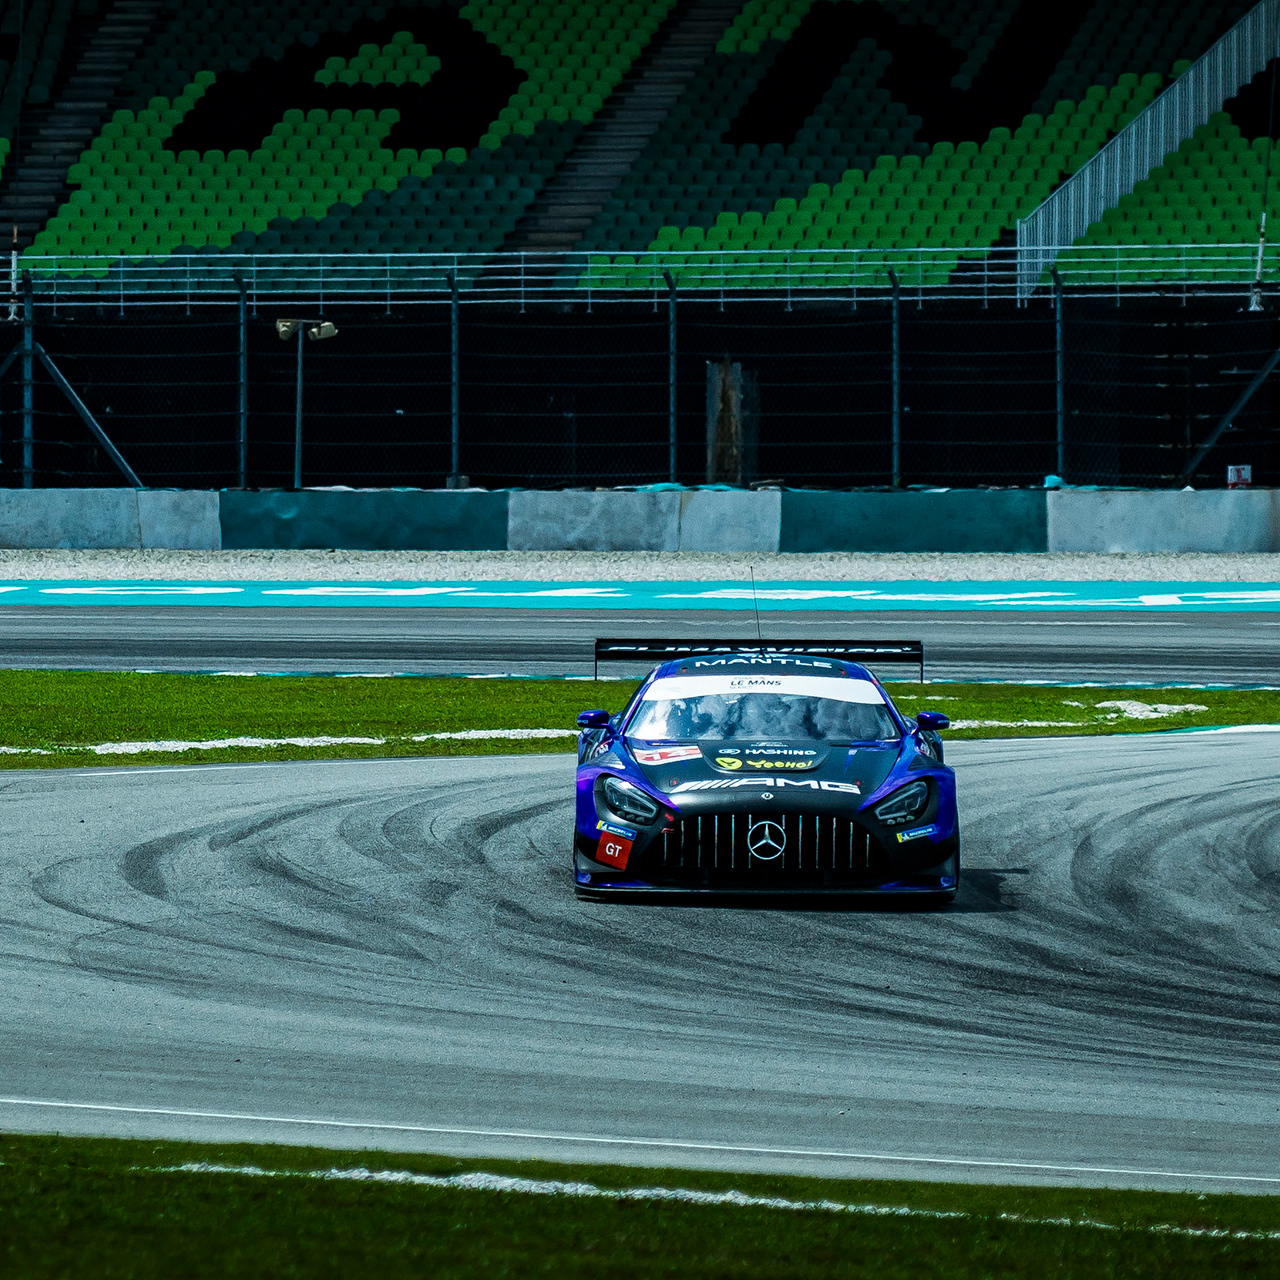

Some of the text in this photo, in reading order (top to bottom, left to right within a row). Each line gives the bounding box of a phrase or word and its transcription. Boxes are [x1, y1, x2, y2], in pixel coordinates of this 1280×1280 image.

[695, 658, 832, 669] MANTLE
[745, 748, 817, 756] HASHING
[605, 842, 622, 858] GT
